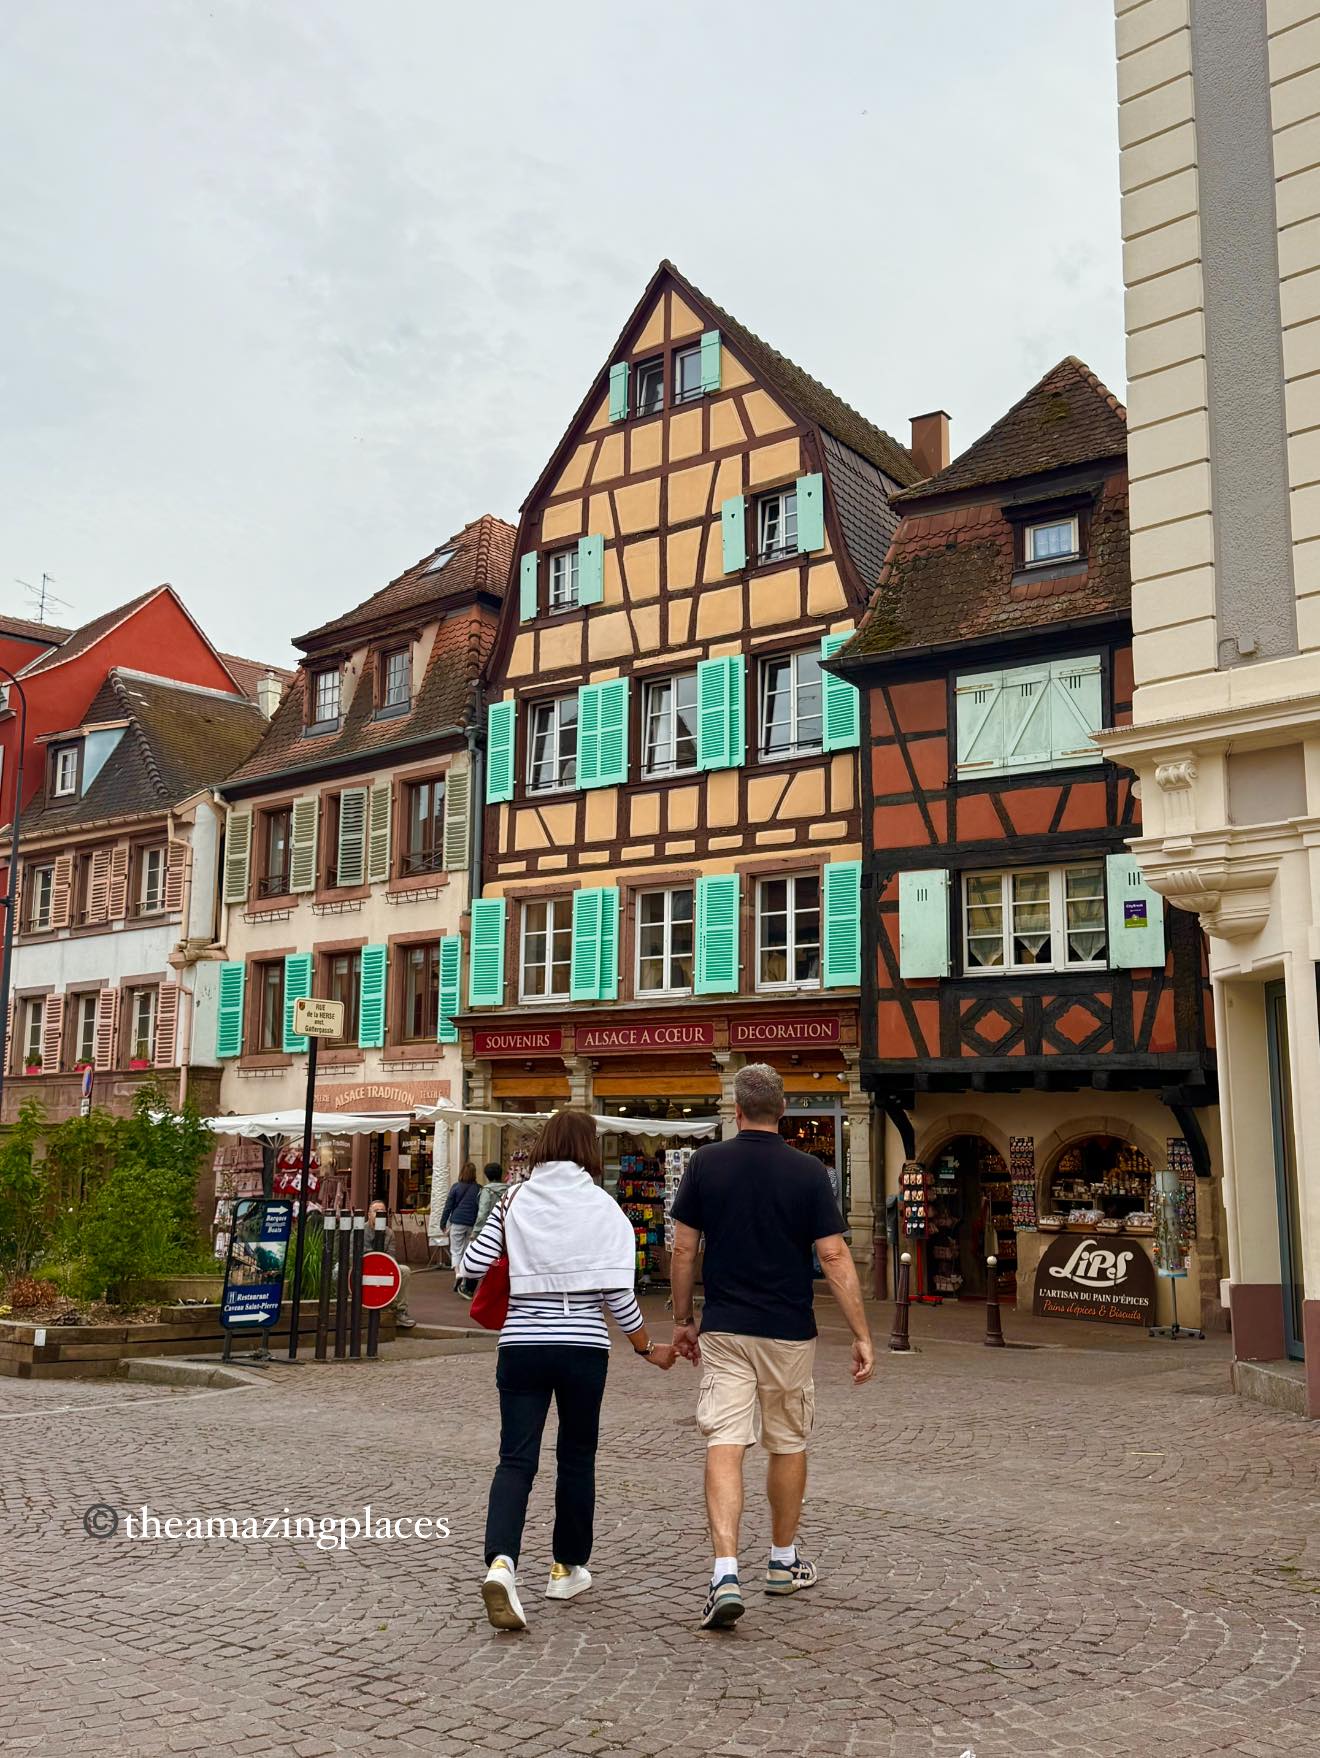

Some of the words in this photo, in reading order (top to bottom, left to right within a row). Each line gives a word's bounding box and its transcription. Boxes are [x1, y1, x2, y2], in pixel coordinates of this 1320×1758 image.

[306, 1010, 313, 1018] de
[320, 1012, 335, 1020] HERSE
[584, 1030, 637, 1046] ALSACE
[641, 1030, 650, 1044] A
[654, 1027, 705, 1043] CŒUR
[737, 1023, 832, 1040] DECORATION
[486, 1033, 550, 1049] SOUVENIRS
[335, 1087, 364, 1108] ALSACE
[367, 1085, 415, 1106] TRADITION
[236, 1292, 270, 1301] Restaurant
[1039, 1288, 1079, 1300] L'ARTISAN
[1080, 1293, 1092, 1302] DU
[1093, 1293, 1111, 1303] PAIN
[1112, 1294, 1149, 1306] D'ÉPICES
[245, 1302, 279, 1310] Saint-Pierre
[1043, 1299, 1065, 1313] Pains
[1098, 1305, 1107, 1317] &
[1108, 1305, 1142, 1320] Biscuits
